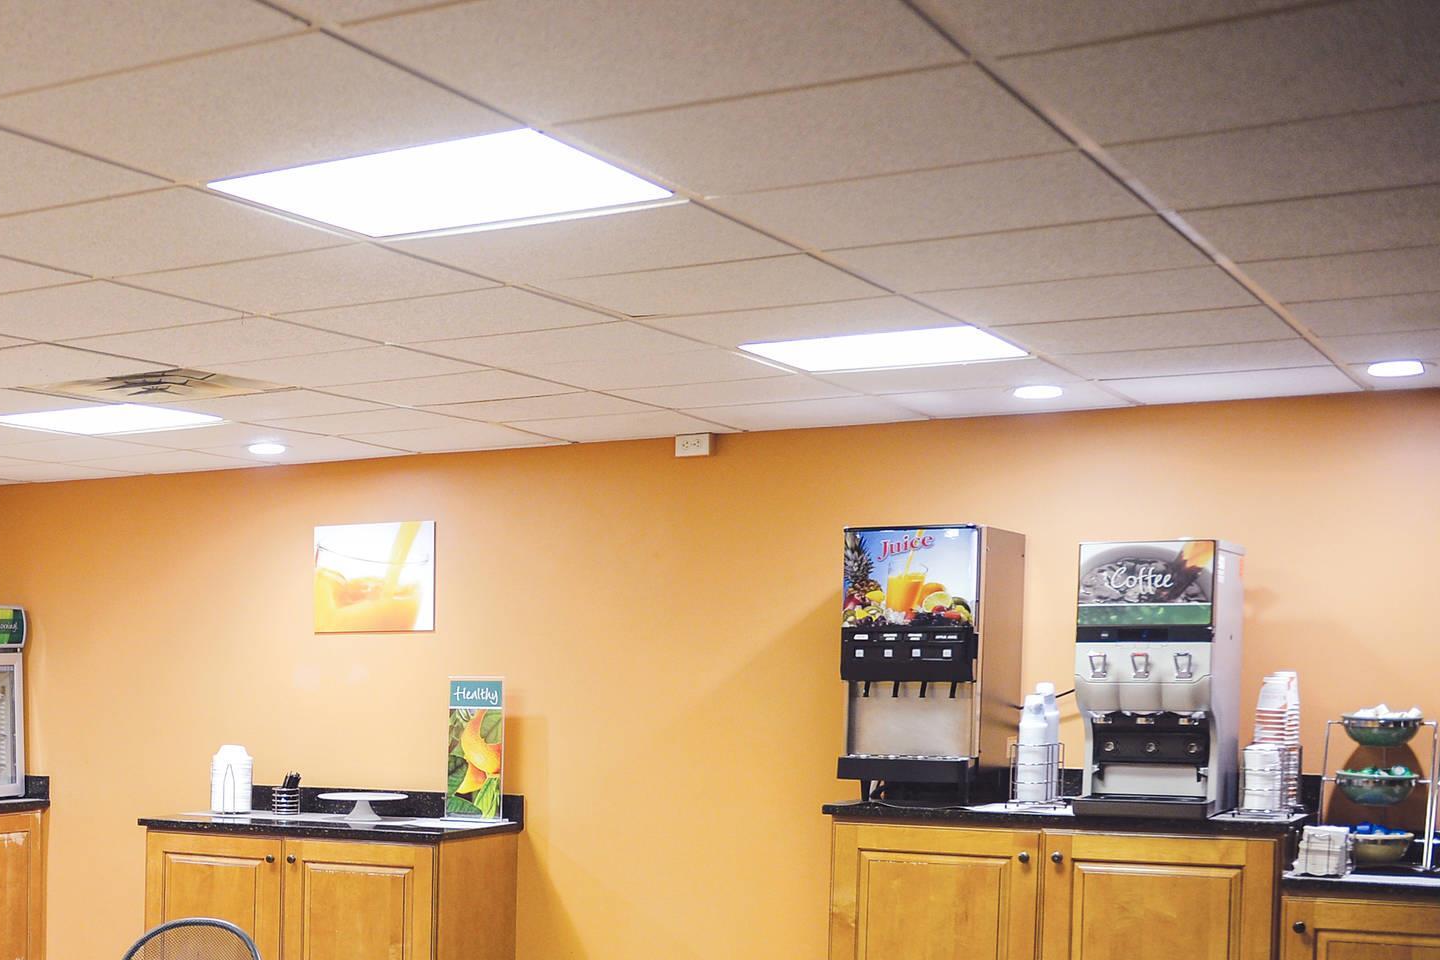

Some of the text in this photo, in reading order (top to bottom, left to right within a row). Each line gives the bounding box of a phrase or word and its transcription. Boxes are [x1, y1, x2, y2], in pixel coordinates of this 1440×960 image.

[877, 534, 935, 562] Juice
[1110, 566, 1174, 595] Coffee
[453, 685, 499, 706] Healthy
